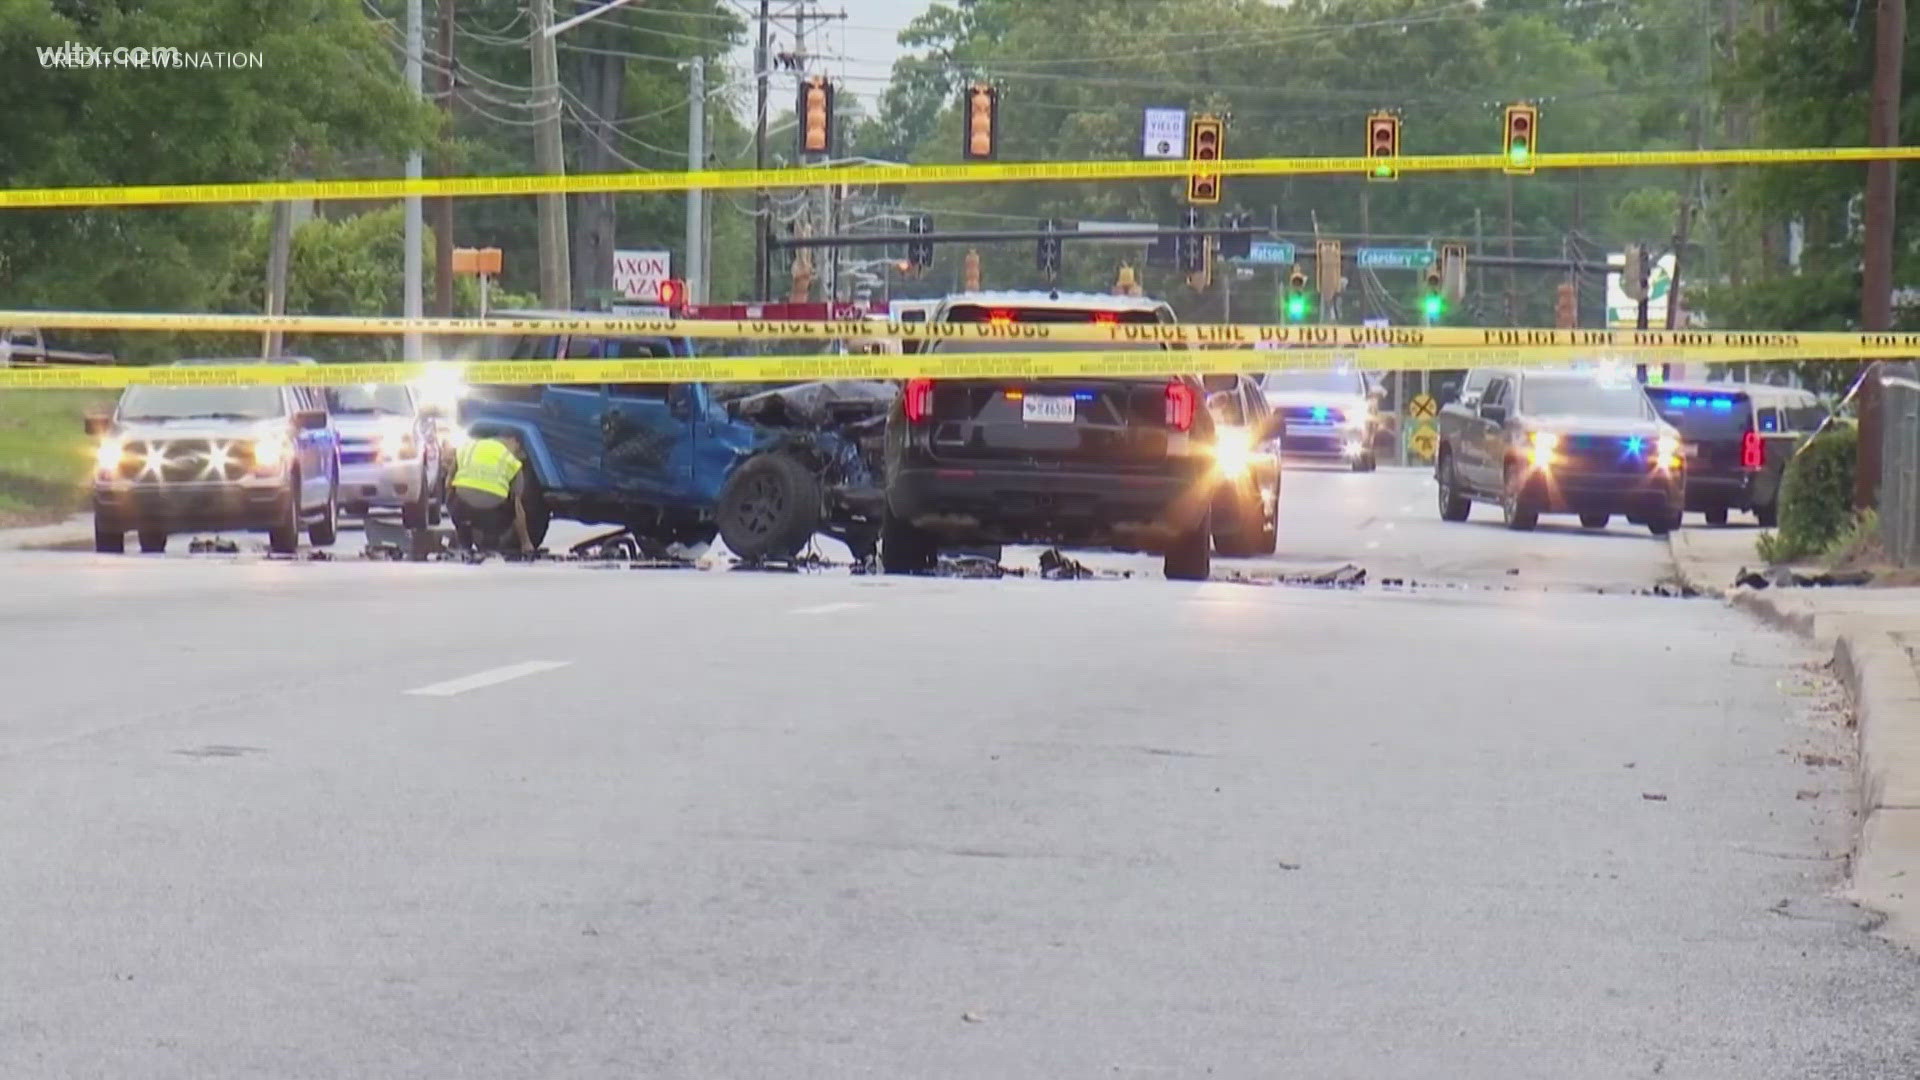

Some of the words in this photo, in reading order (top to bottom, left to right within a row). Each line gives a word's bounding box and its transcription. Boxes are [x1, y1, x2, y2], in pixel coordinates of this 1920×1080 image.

[1151, 121, 1180, 130] YIELD
[1485, 330, 1555, 344] POLICE
[1570, 331, 1613, 345] LINE
[1634, 332, 1663, 345] DO
[1673, 332, 1712, 345] NOT
[1725, 333, 1799, 346] CROSS
